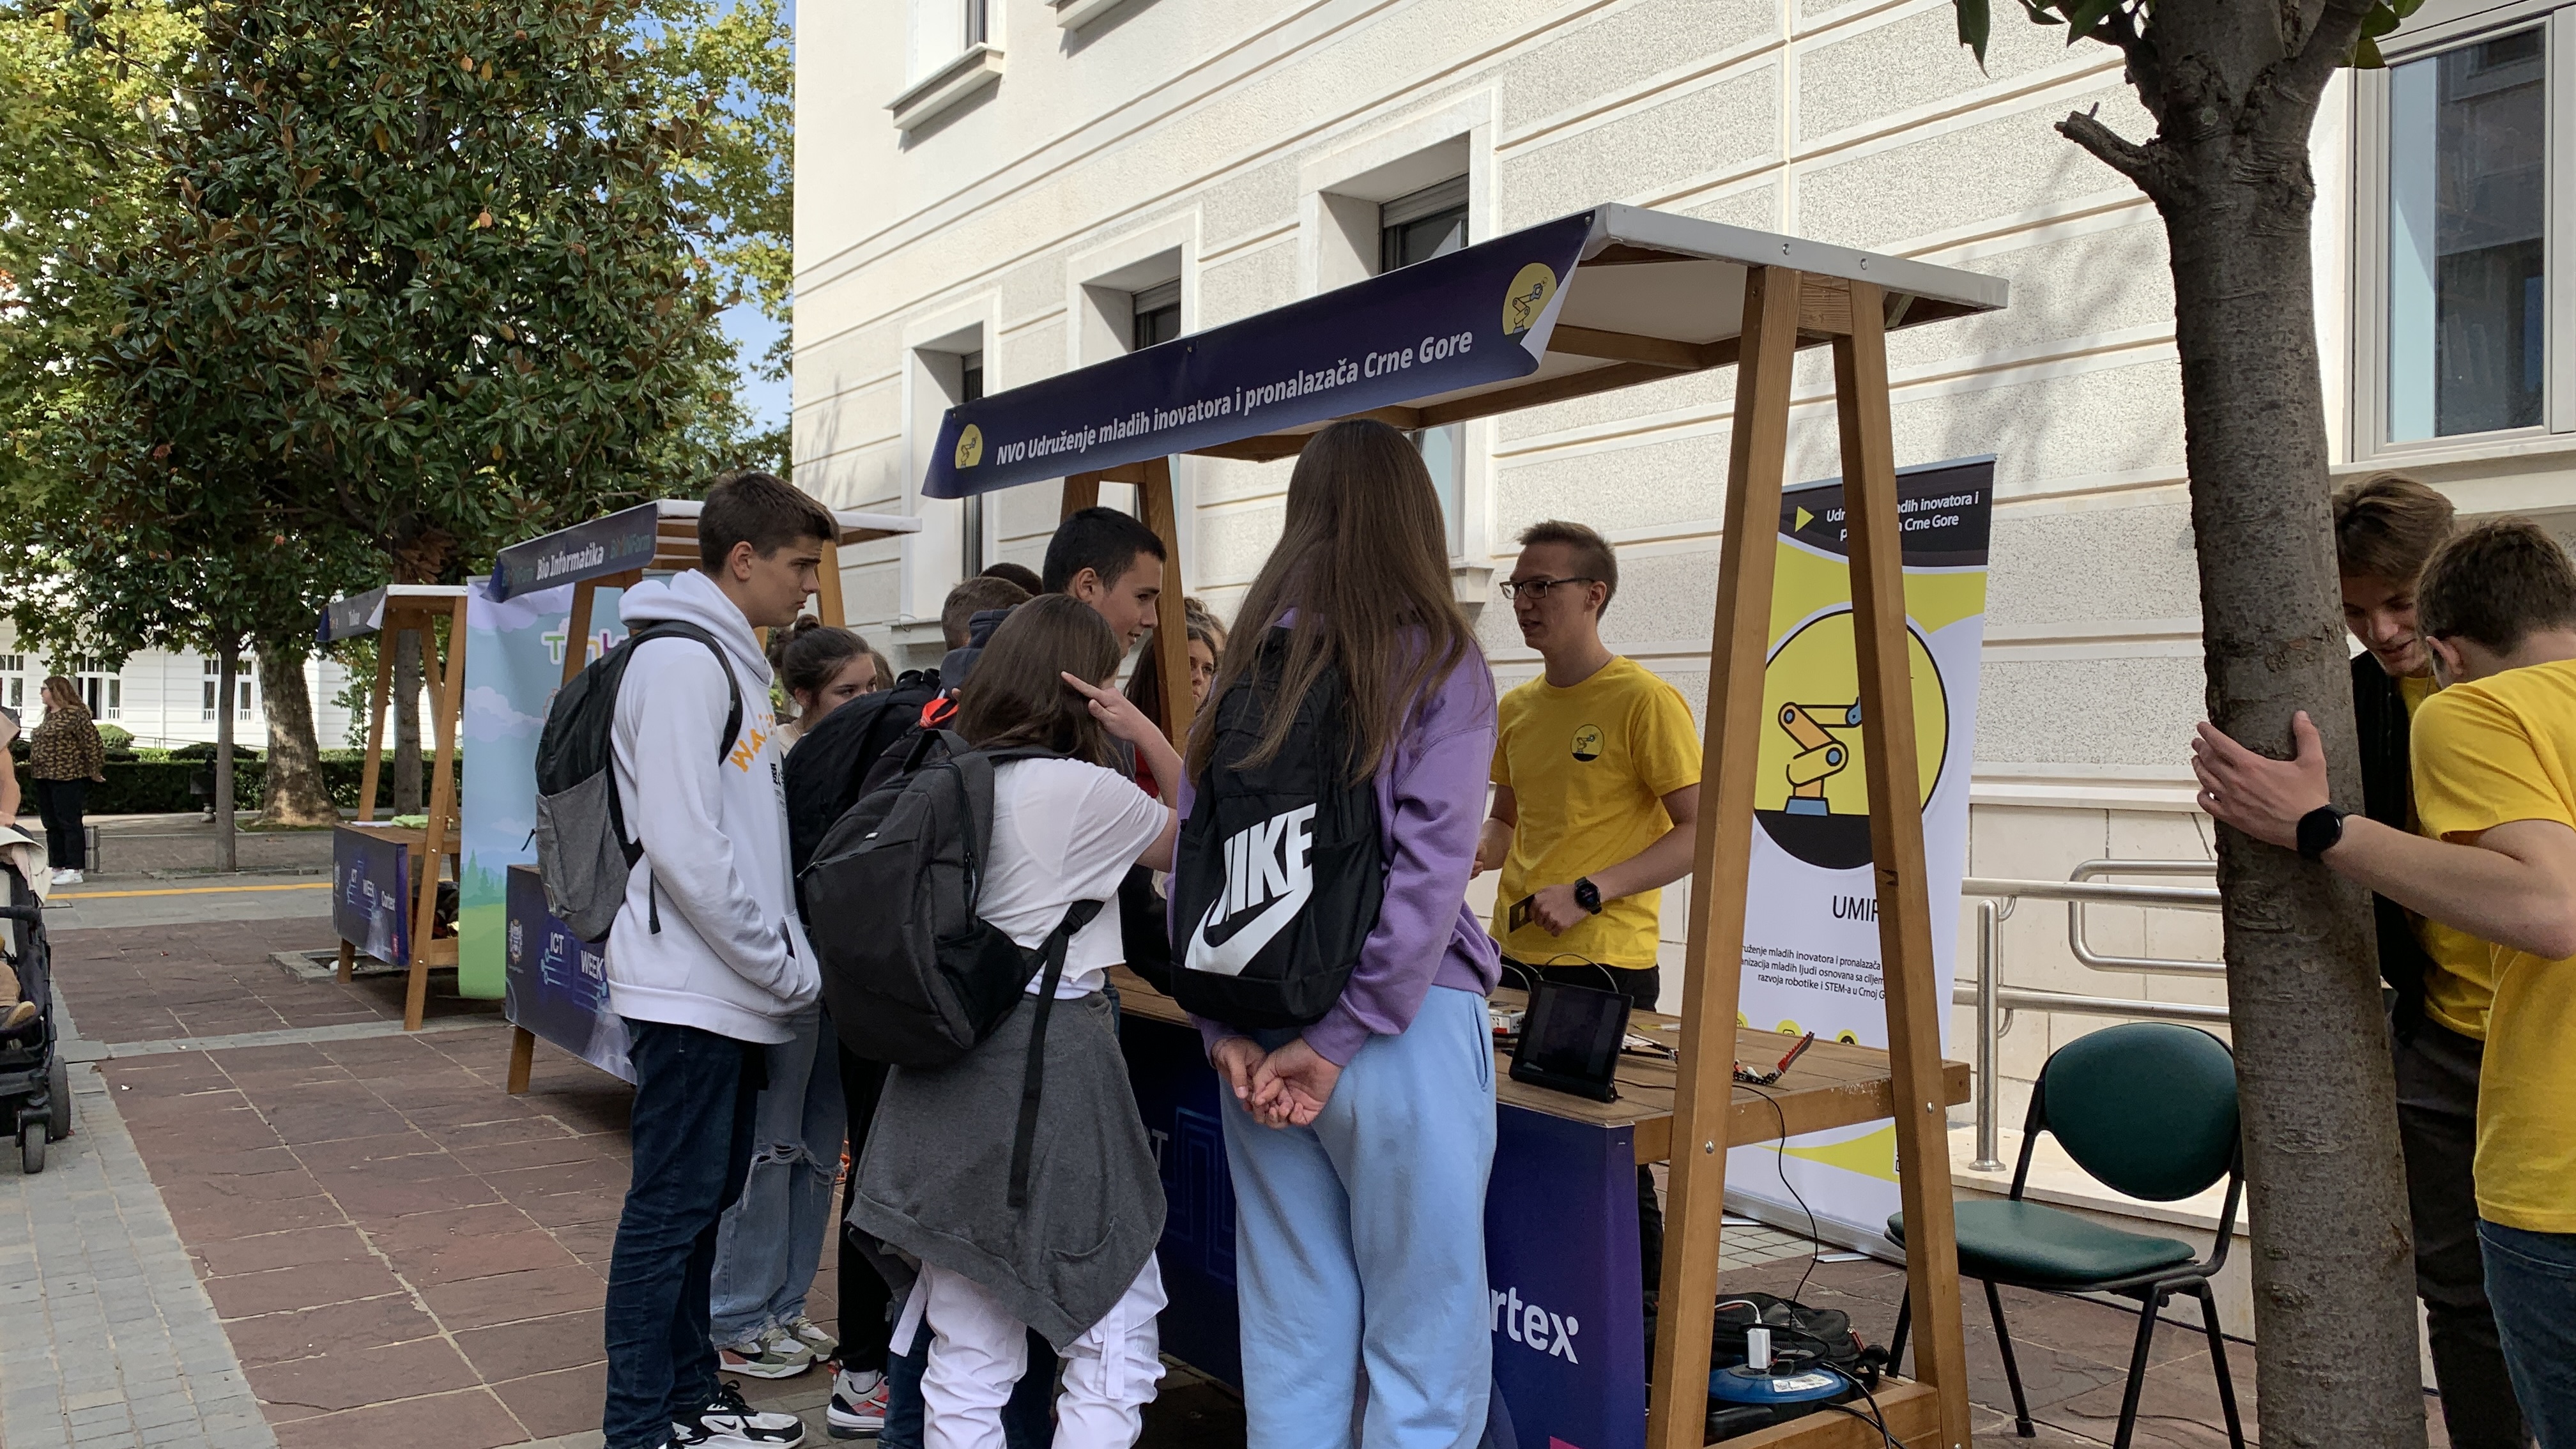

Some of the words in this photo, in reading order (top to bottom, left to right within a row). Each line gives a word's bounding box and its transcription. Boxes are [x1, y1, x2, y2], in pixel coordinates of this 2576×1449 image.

[997, 441, 1025, 465] NVO
[1028, 425, 1096, 458] Udruženje
[1099, 411, 1149, 443] mladih
[1153, 396, 1230, 431] inovatora
[1235, 387, 1241, 411] i
[1244, 358, 1358, 415] pronalazača
[1364, 348, 1413, 378] Crne
[1419, 331, 1473, 364] Gore
[1920, 494, 1972, 511] inovatora
[1975, 491, 1979, 504] i
[1905, 518, 1929, 532] Crne
[1932, 514, 1959, 528] Gore
[536, 556, 549, 581] Bio
[550, 542, 604, 577] Informatika
[550, 931, 564, 955] ICT
[581, 949, 604, 981] WEEK
[1741, 958, 1769, 970] anizacija
[1771, 961, 1797, 972] mladih
[1799, 963, 1817, 976] ljudi
[1819, 969, 1853, 981] osnovana
[1855, 974, 1862, 982] sa
[1768, 947, 1794, 959] mladih
[1796, 951, 1834, 964] inovatora
[1839, 957, 1880, 970] pronalazača
[1758, 974, 1783, 985] razvoja
[1785, 977, 1819, 990] robotike
[1825, 981, 1851, 994] STEM-a
[1859, 987, 1878, 1000] Crnoj
[1491, 1287, 1579, 1365] rtex
